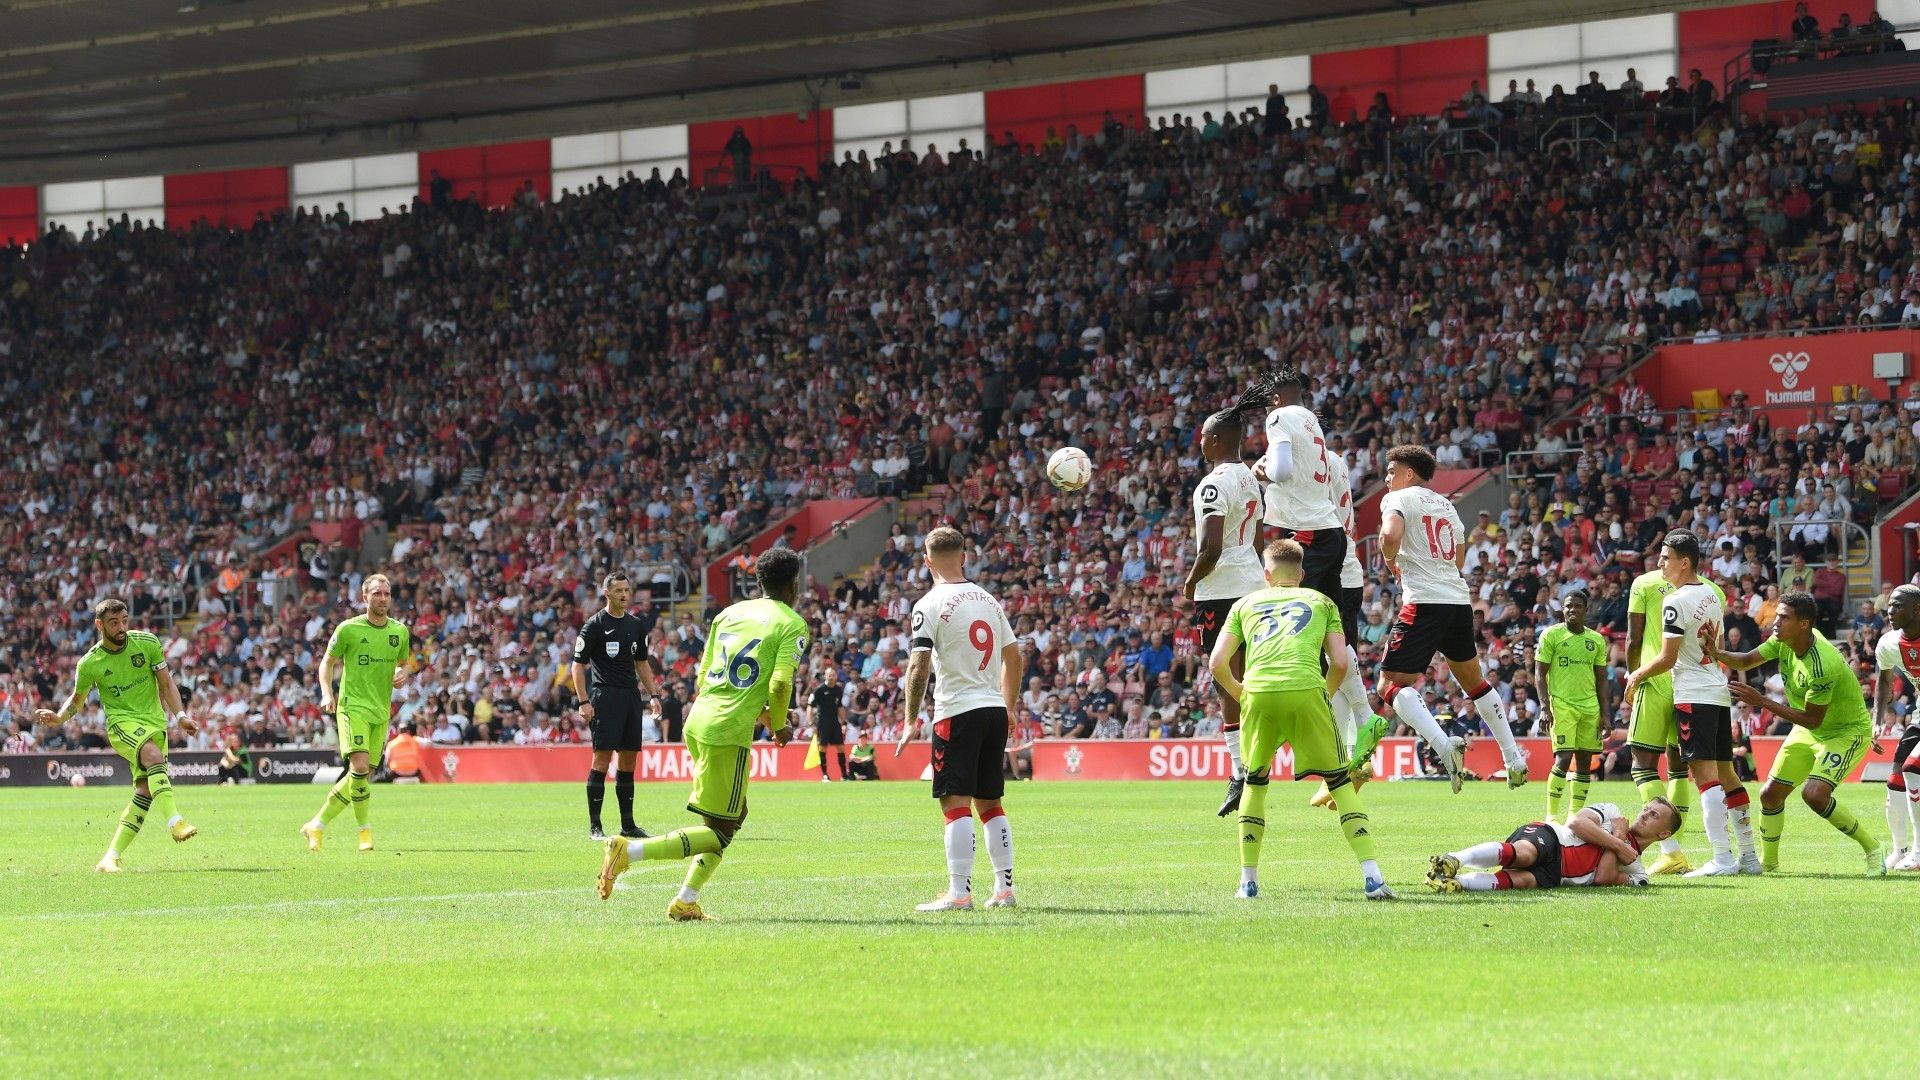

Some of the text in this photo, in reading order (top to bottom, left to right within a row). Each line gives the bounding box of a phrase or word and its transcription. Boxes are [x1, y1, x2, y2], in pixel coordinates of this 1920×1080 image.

[1765, 387, 1815, 404] hummel
[1202, 487, 1217, 502] JD
[1238, 500, 1258, 546] 7
[1421, 514, 1456, 561] 10
[1252, 601, 1313, 643] 39
[1663, 609, 1677, 621] JD
[1196, 624, 1205, 646] 7
[968, 619, 994, 672] 9
[704, 632, 762, 689] 36
[273, 760, 328, 777] Sportsbet.i
[1821, 751, 1842, 769] 19
[60, 762, 114, 781] Sportsbet.io
[1001, 828, 1009, 848] SFC
